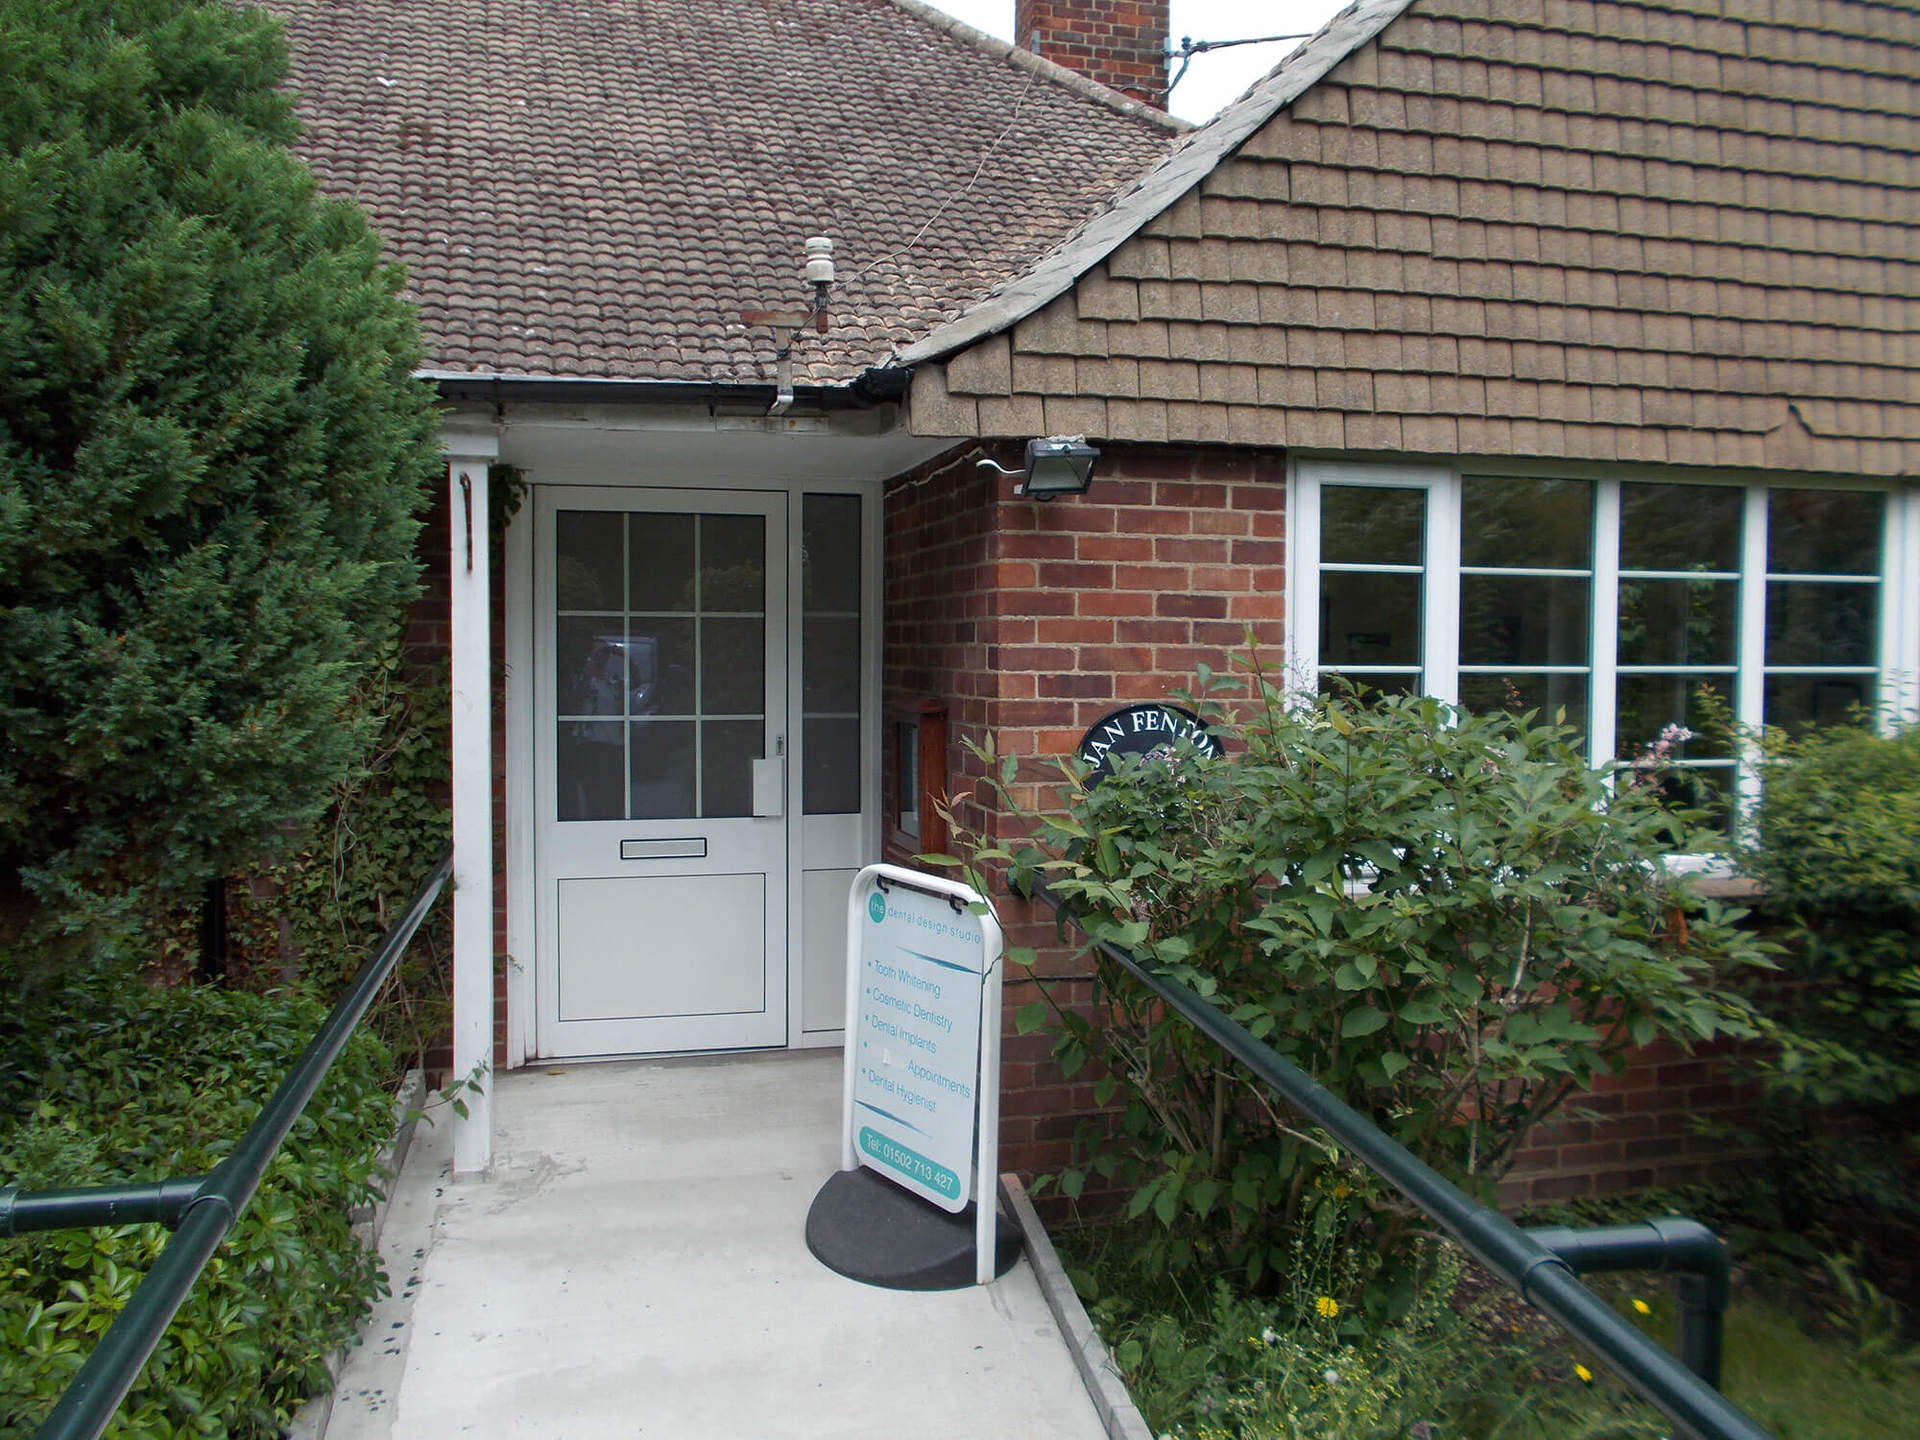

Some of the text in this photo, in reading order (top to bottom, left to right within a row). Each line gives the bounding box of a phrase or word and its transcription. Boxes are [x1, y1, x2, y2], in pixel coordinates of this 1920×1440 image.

[1083, 718, 1126, 768] JAN
[871, 901, 980, 944] the dental design studio
[874, 960, 941, 999] Tooth Whitening
[873, 987, 952, 1033] Cosmetic Dentistry
[872, 1015, 936, 1054] Dental Implants
[868, 1069, 936, 1112] Dental Hygienist
[906, 1060, 970, 1098] Appointments
[866, 1134, 953, 1191] Tel: 01502 713 427
